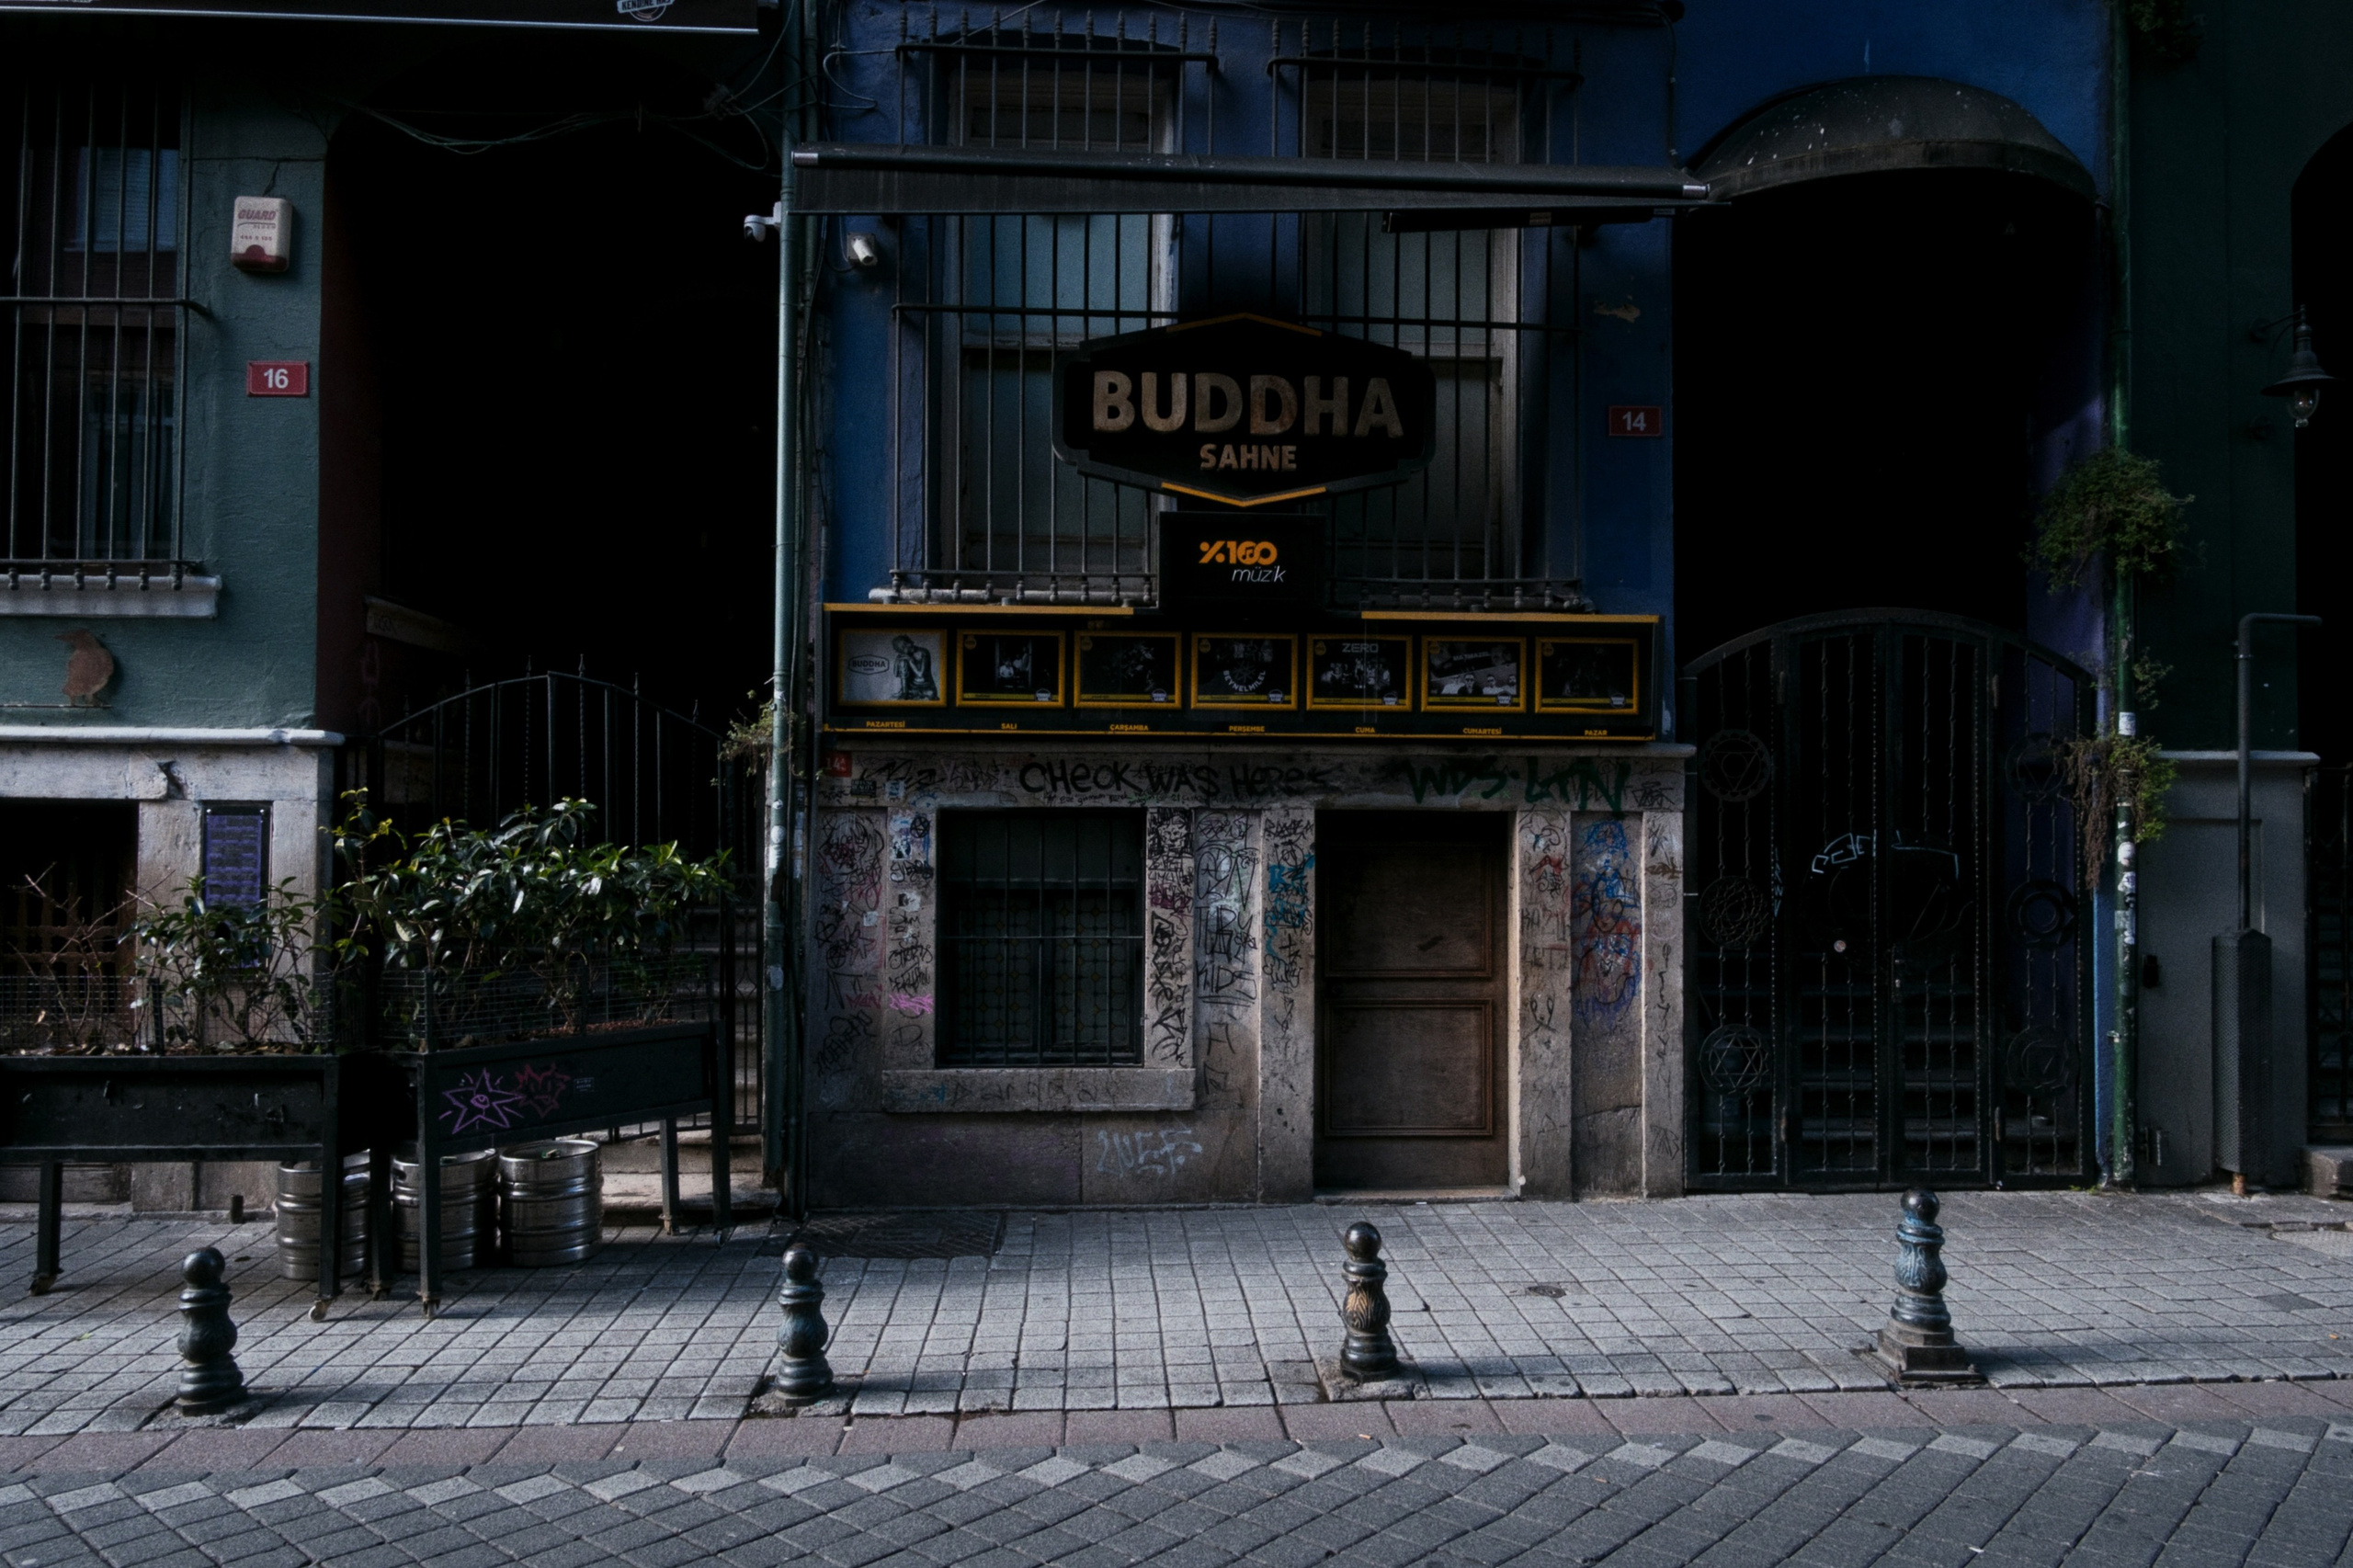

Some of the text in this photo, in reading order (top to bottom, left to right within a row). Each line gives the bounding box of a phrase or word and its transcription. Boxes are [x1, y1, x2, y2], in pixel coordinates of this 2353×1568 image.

[237, 210, 277, 221] GUARD
[264, 368, 289, 390] 16
[1092, 369, 1404, 439] BUDDHA
[1621, 411, 1646, 433] 14
[1199, 442, 1298, 473] SAHNE
[1231, 565, 1287, 583] müzik
[1341, 642, 1380, 653] ZERO
[852, 660, 887, 668] BUDDHA
[865, 720, 906, 728] PAZARTESİ
[1461, 726, 1502, 735] CUMARTESİ
